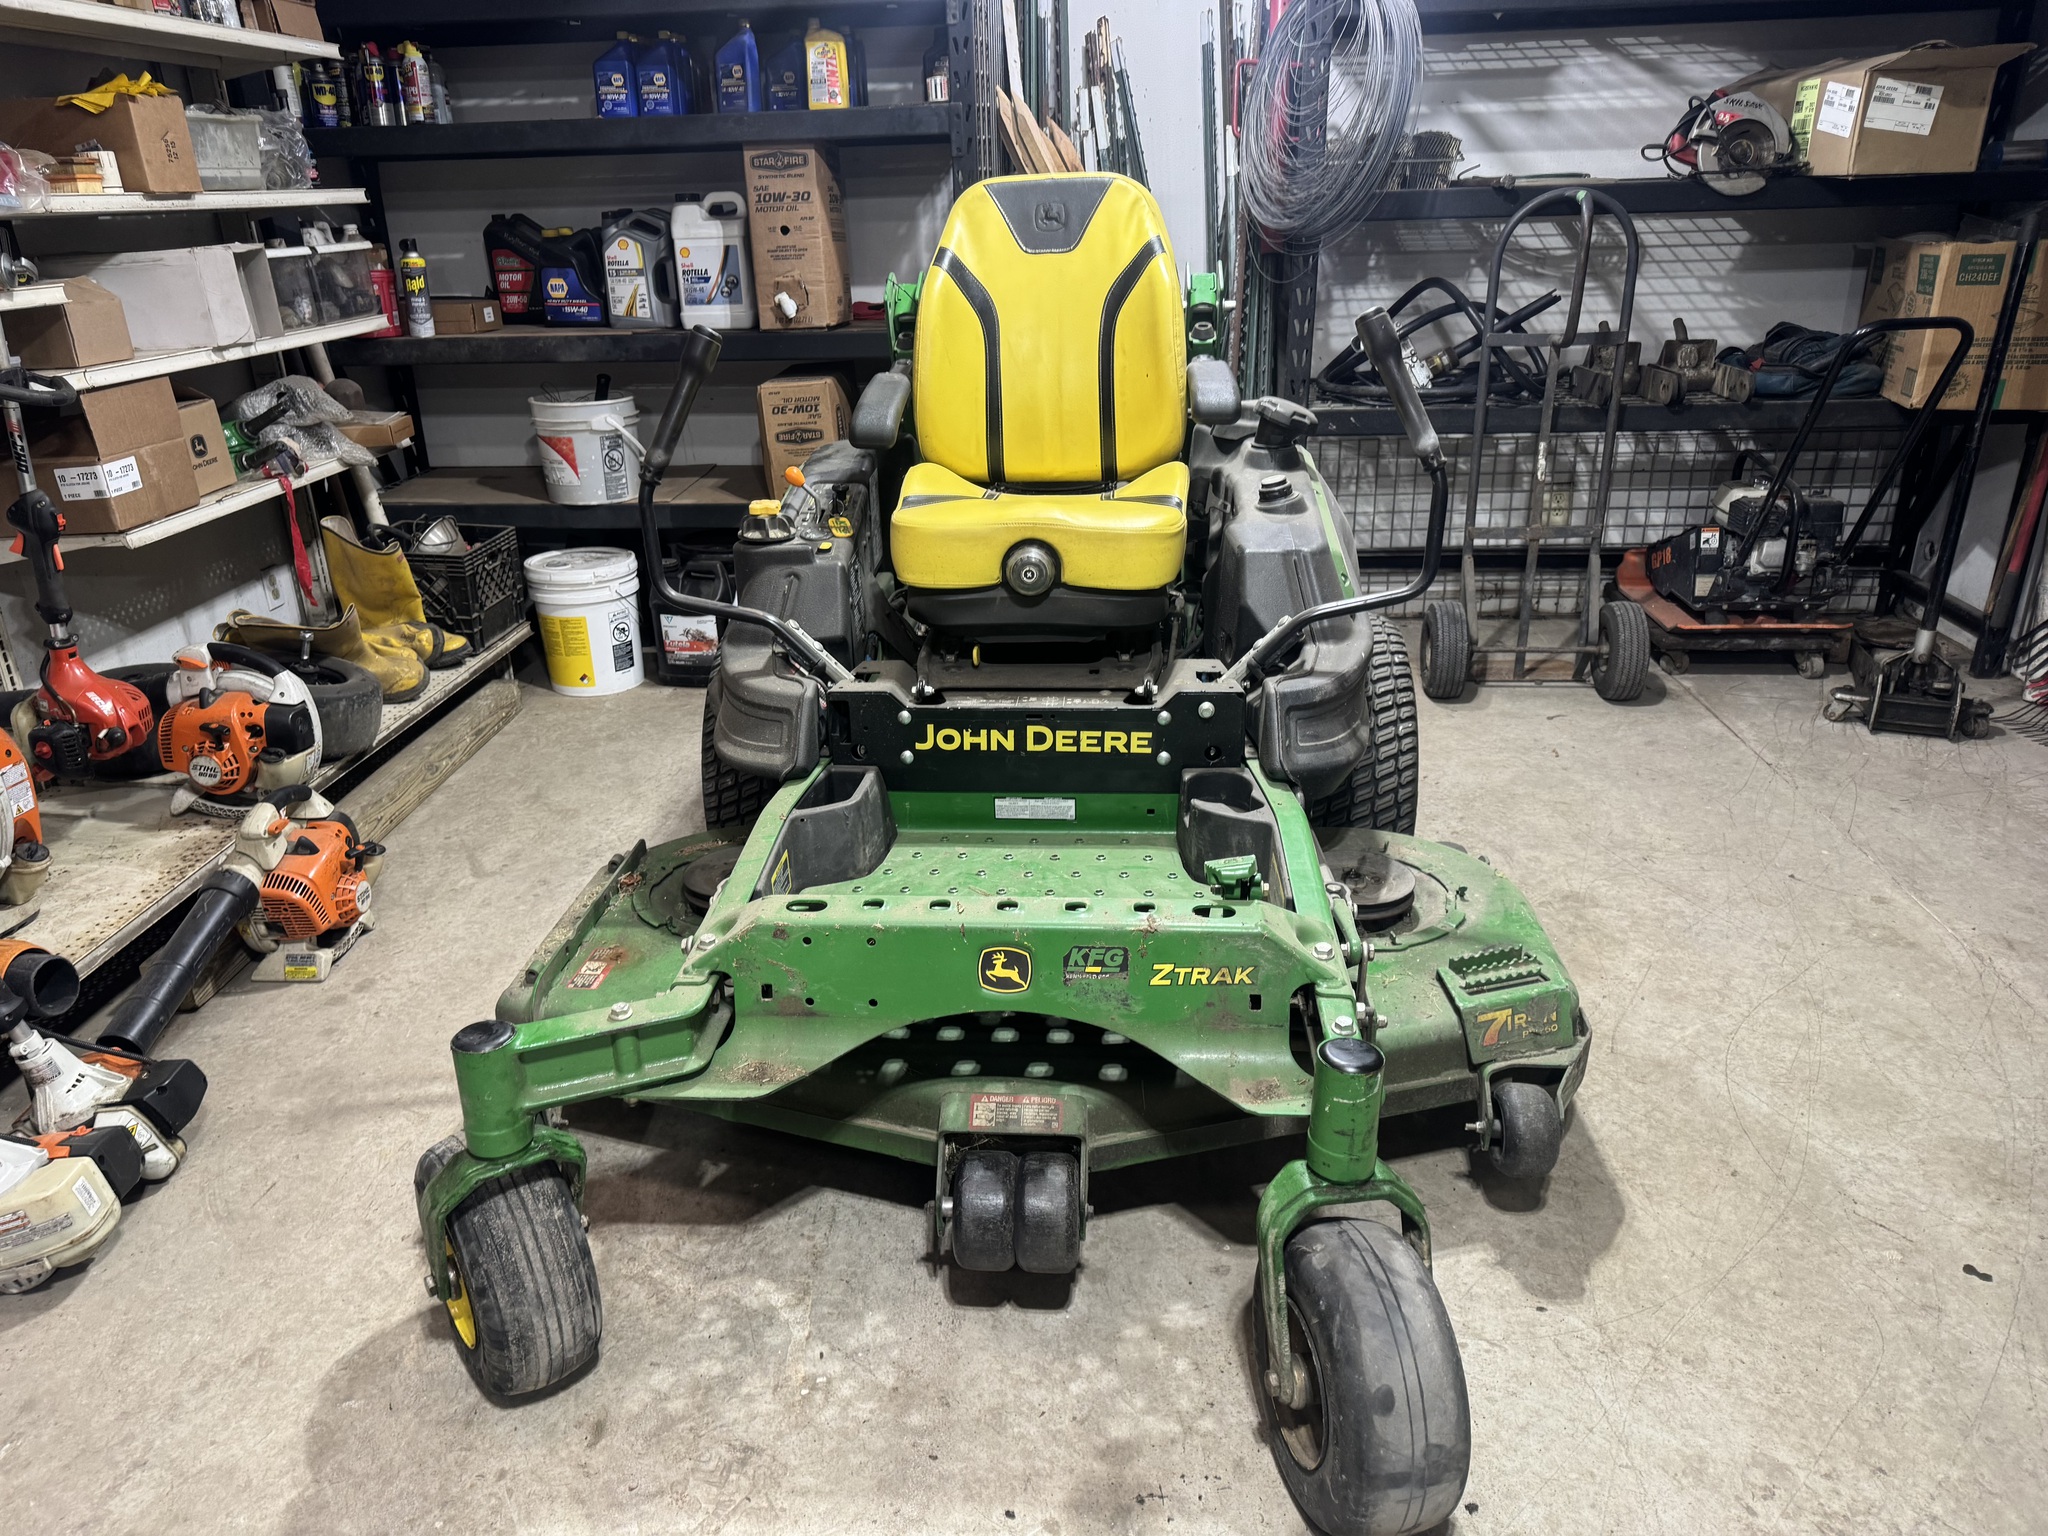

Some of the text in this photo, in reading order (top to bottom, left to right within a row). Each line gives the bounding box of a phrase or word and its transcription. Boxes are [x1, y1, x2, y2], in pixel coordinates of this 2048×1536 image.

[754, 155, 804, 167] STAR FIRE
[754, 191, 811, 204] 10W-30
[681, 268, 709, 277] ROTELLA
[1958, 272, 1999, 282] CH24DEF
[498, 274, 522, 282] MOTOR
[405, 275, 425, 292] Raid
[500, 281, 511, 289] OIL
[550, 283, 565, 293] NAPA
[506, 296, 527, 304] 20W-50
[771, 404, 821, 416] 10W-30
[778, 431, 821, 441] STAR FIRE
[192, 456, 218, 471] OHN DEERE
[57, 474, 66, 483] 10
[106, 469, 113, 478] 10
[1651, 546, 1672, 570] GP18
[915, 724, 1153, 754] JOHN DEERE
[191, 764, 219, 774] STIHL
[357, 886, 370, 903] STIHL
[1068, 948, 1124, 967] KFG
[1030, 1096, 1057, 1104] PELIGRO
